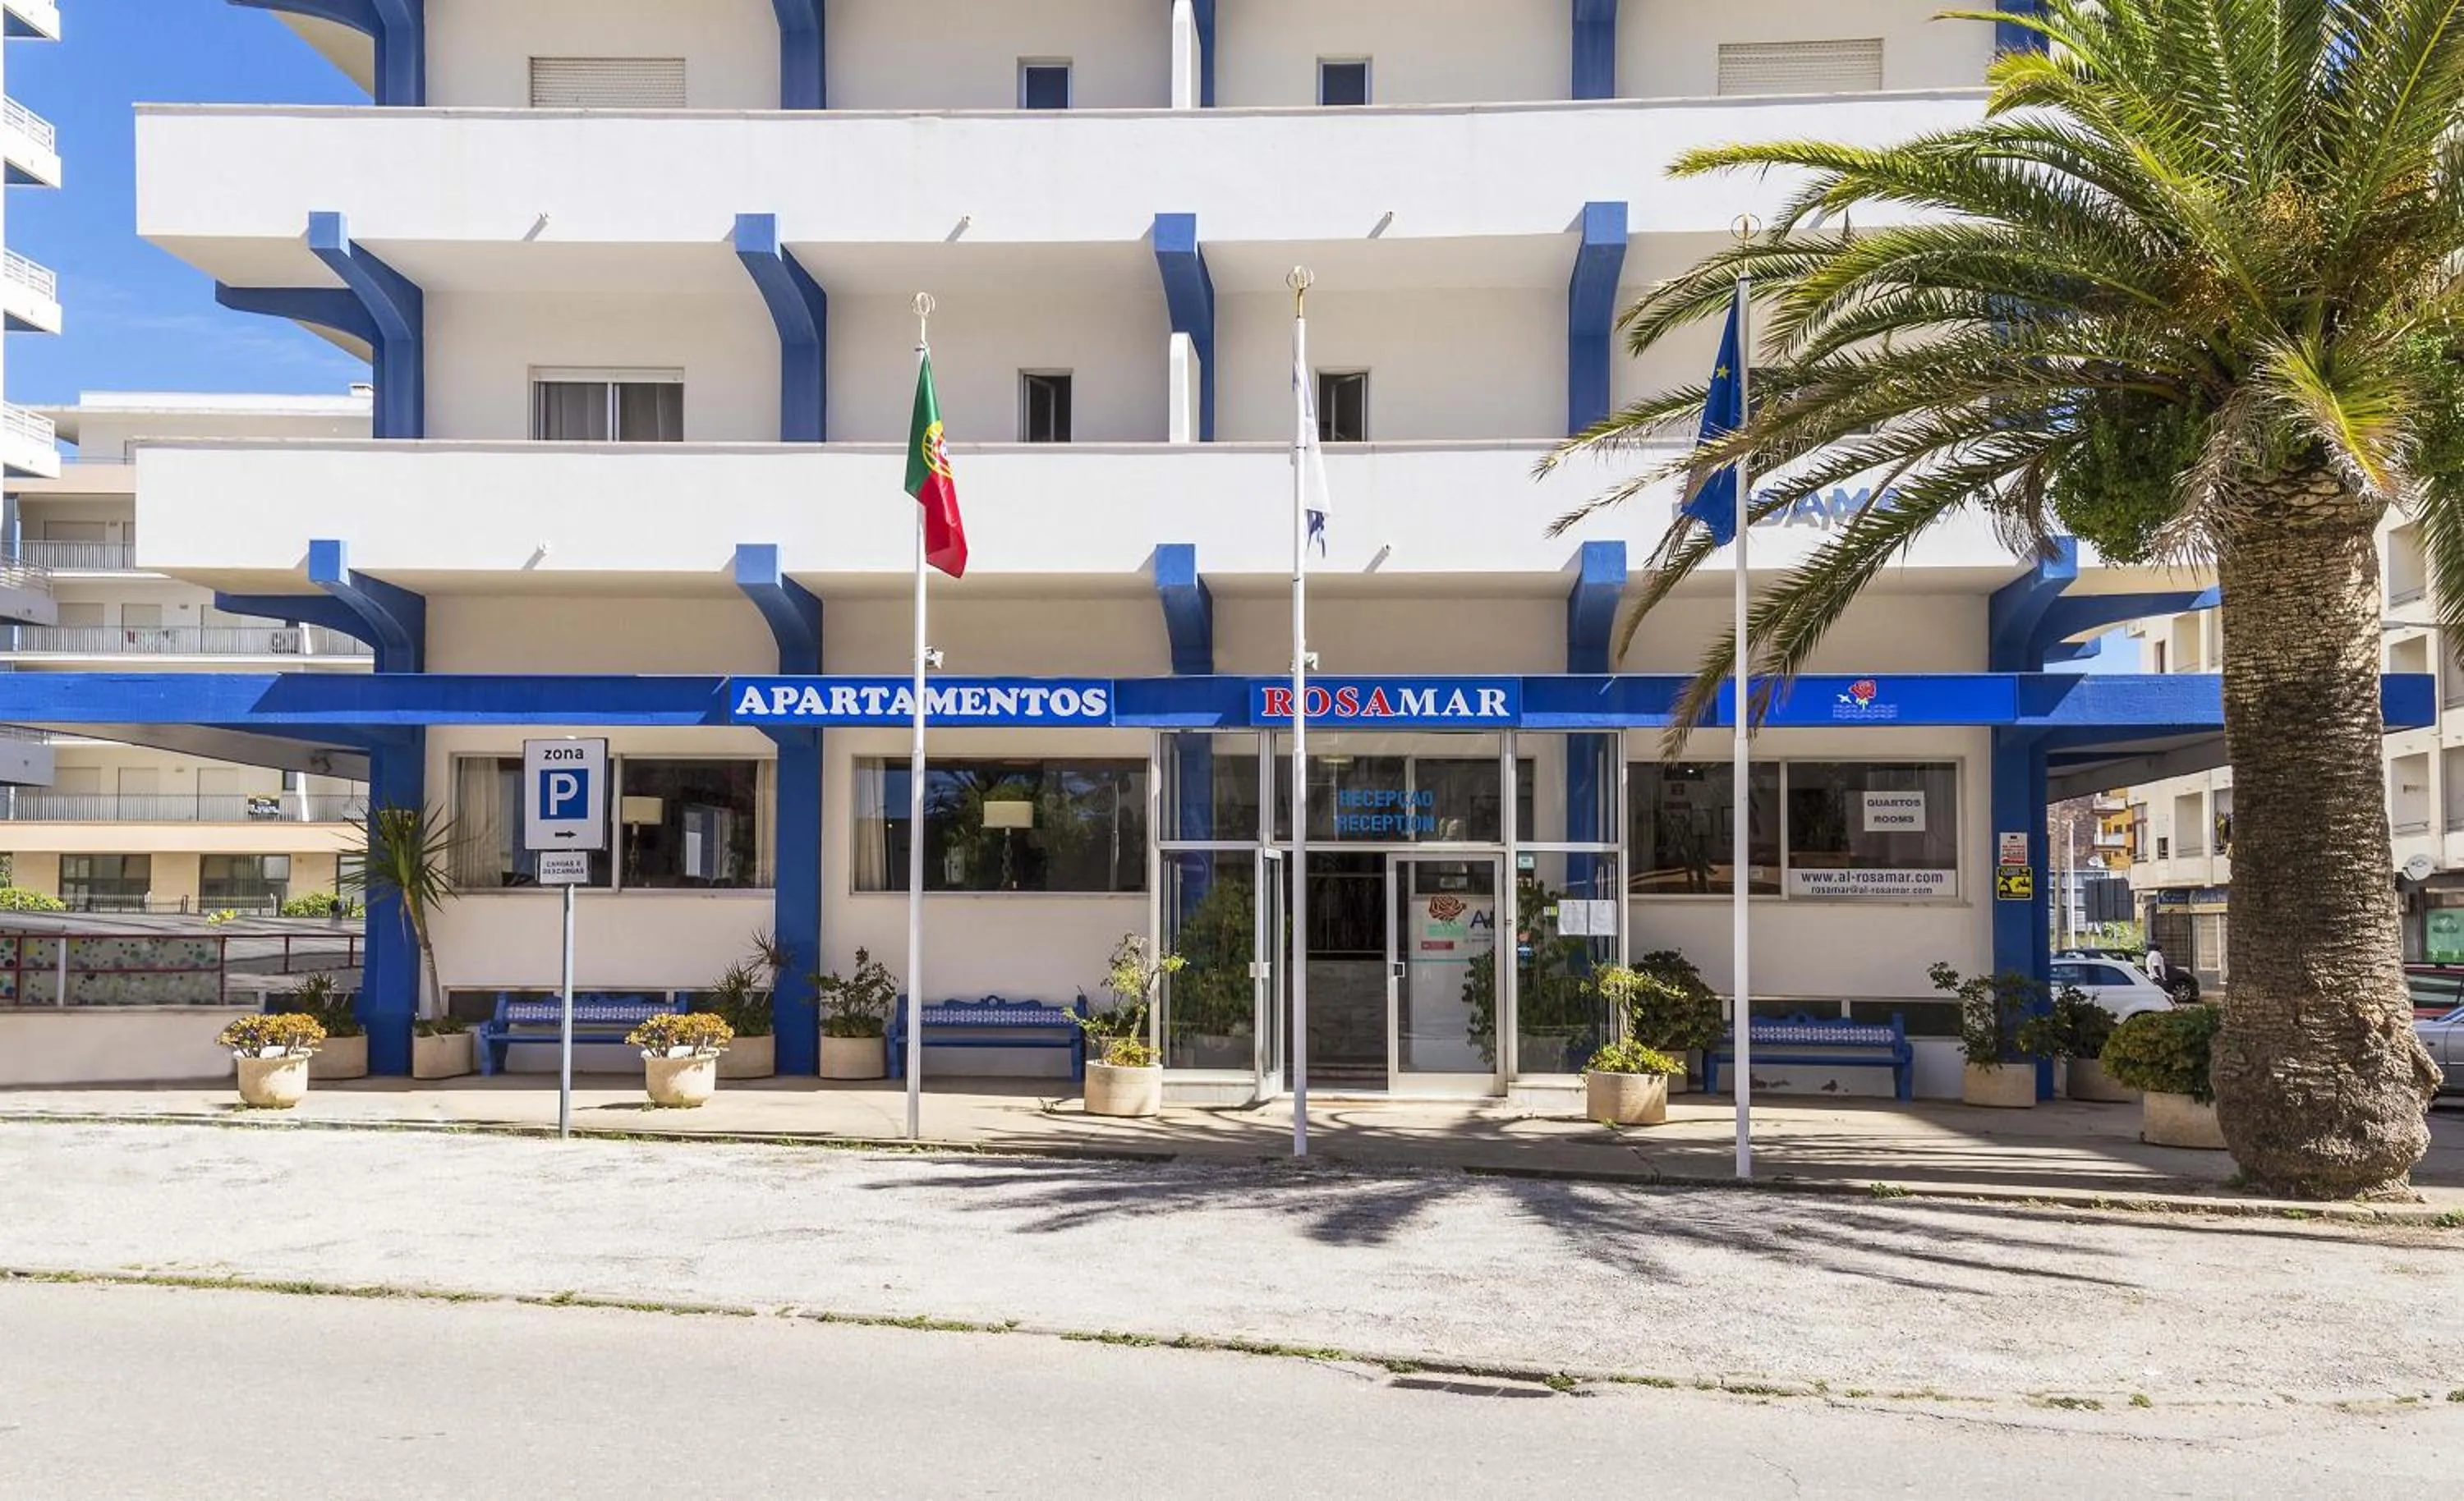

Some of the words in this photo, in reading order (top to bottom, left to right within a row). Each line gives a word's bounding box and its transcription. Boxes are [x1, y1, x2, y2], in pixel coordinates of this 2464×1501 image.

[735, 686, 1108, 717] APARTAMENTOS
[1262, 686, 1510, 717] ROSAMAR
[544, 748, 584, 760] zona
[549, 773, 578, 815] P
[1867, 799, 1921, 807] QUARTOS
[1336, 814, 1435, 832] RECEPTION
[1873, 815, 1915, 824] ROOMS
[1801, 871, 1943, 884] www.al-rosamar.com
